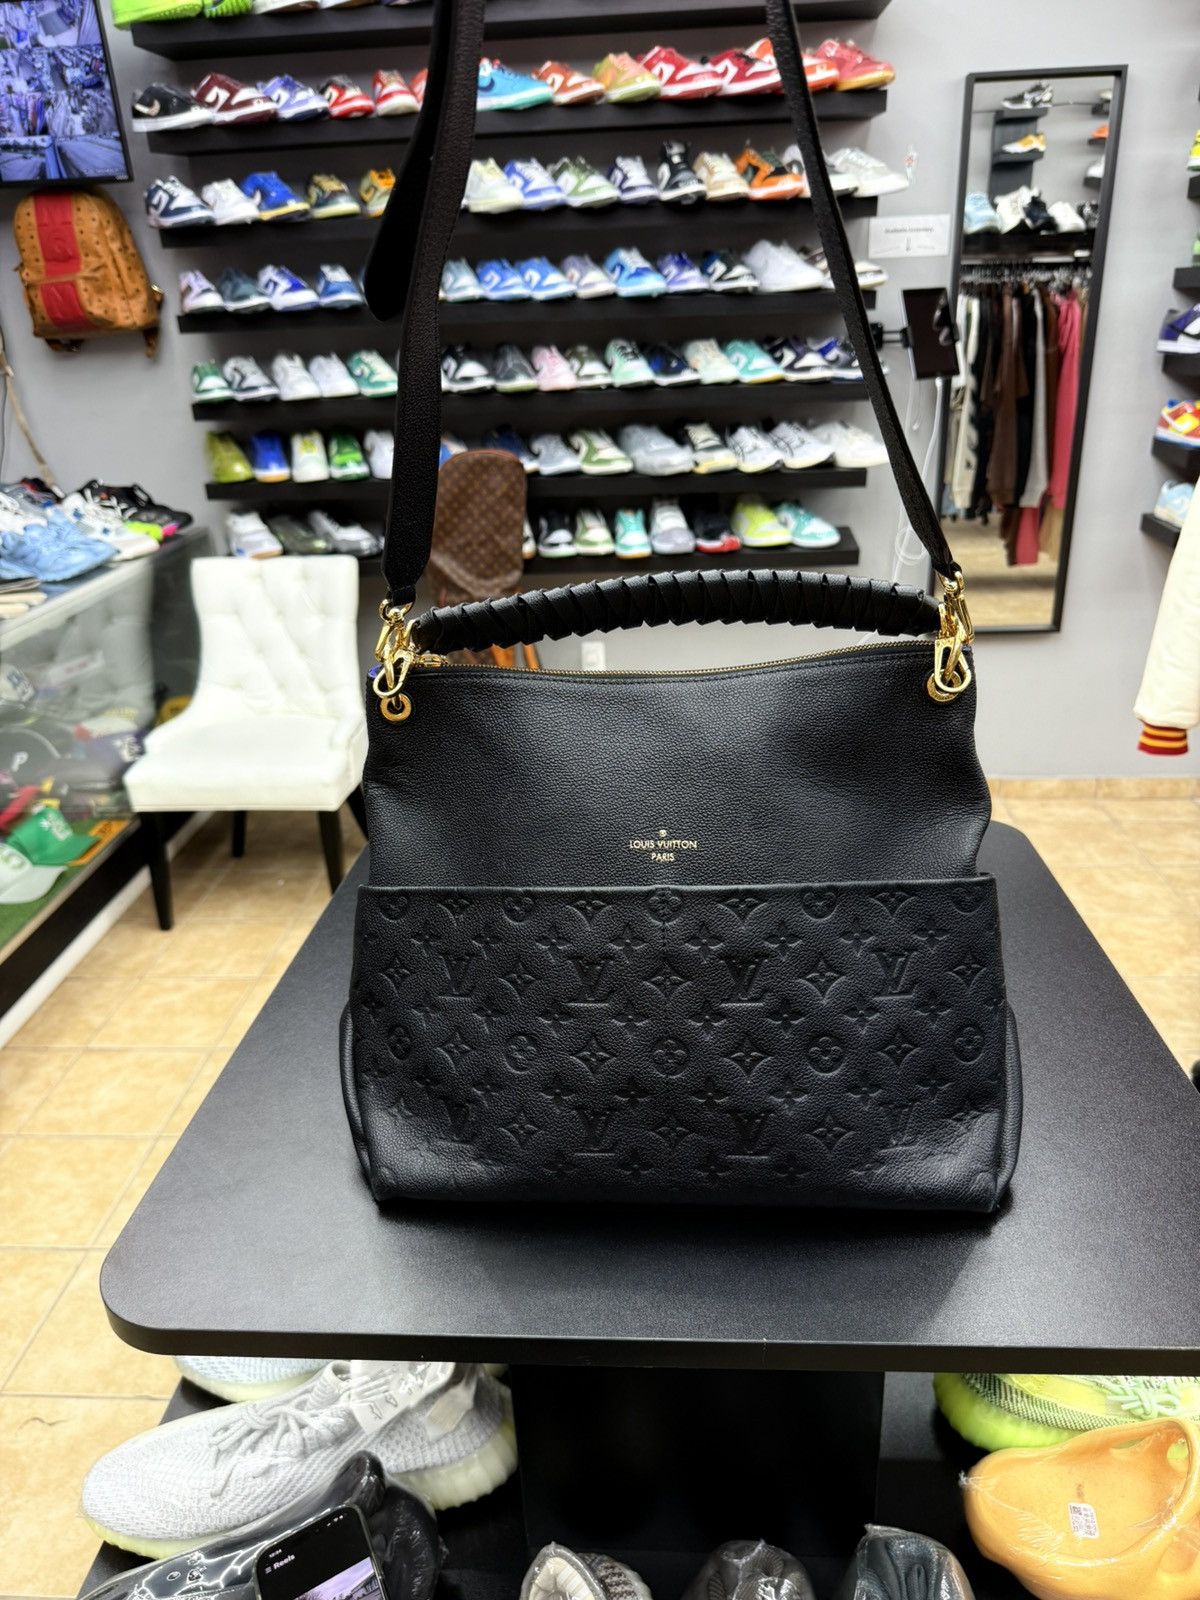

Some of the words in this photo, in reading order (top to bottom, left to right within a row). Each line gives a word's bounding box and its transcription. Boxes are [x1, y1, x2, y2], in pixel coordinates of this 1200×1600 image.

[629, 840, 655, 849] LOUIS
[657, 840, 698, 849] VUITTON
[651, 852, 675, 862] PARIS
